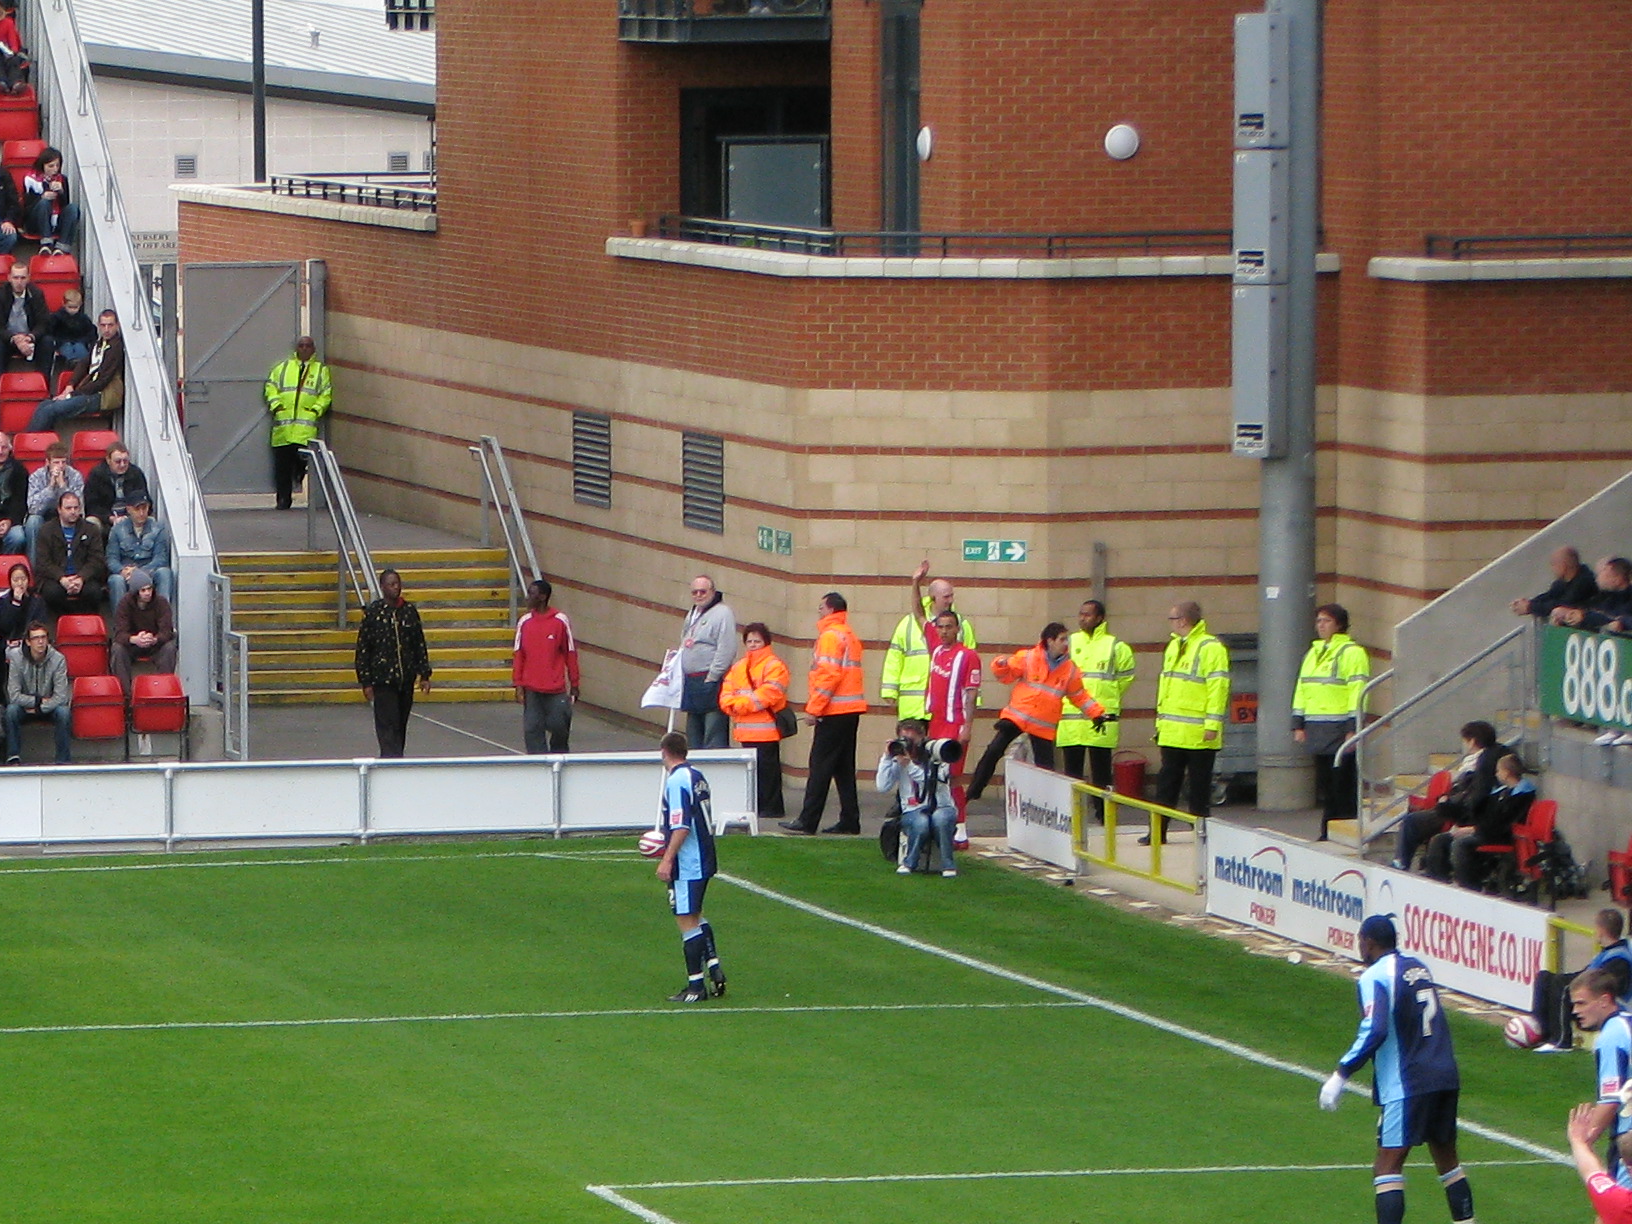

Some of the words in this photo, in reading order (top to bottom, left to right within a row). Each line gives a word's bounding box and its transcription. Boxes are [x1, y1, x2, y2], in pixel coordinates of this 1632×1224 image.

[965, 546, 983, 555] EXIT
[1214, 855, 1284, 899] matchroom
[1292, 877, 1364, 922] matchroom
[1403, 902, 1543, 986] SOCCERSCENE.CO.UK
[1415, 988, 1437, 1037] 7
